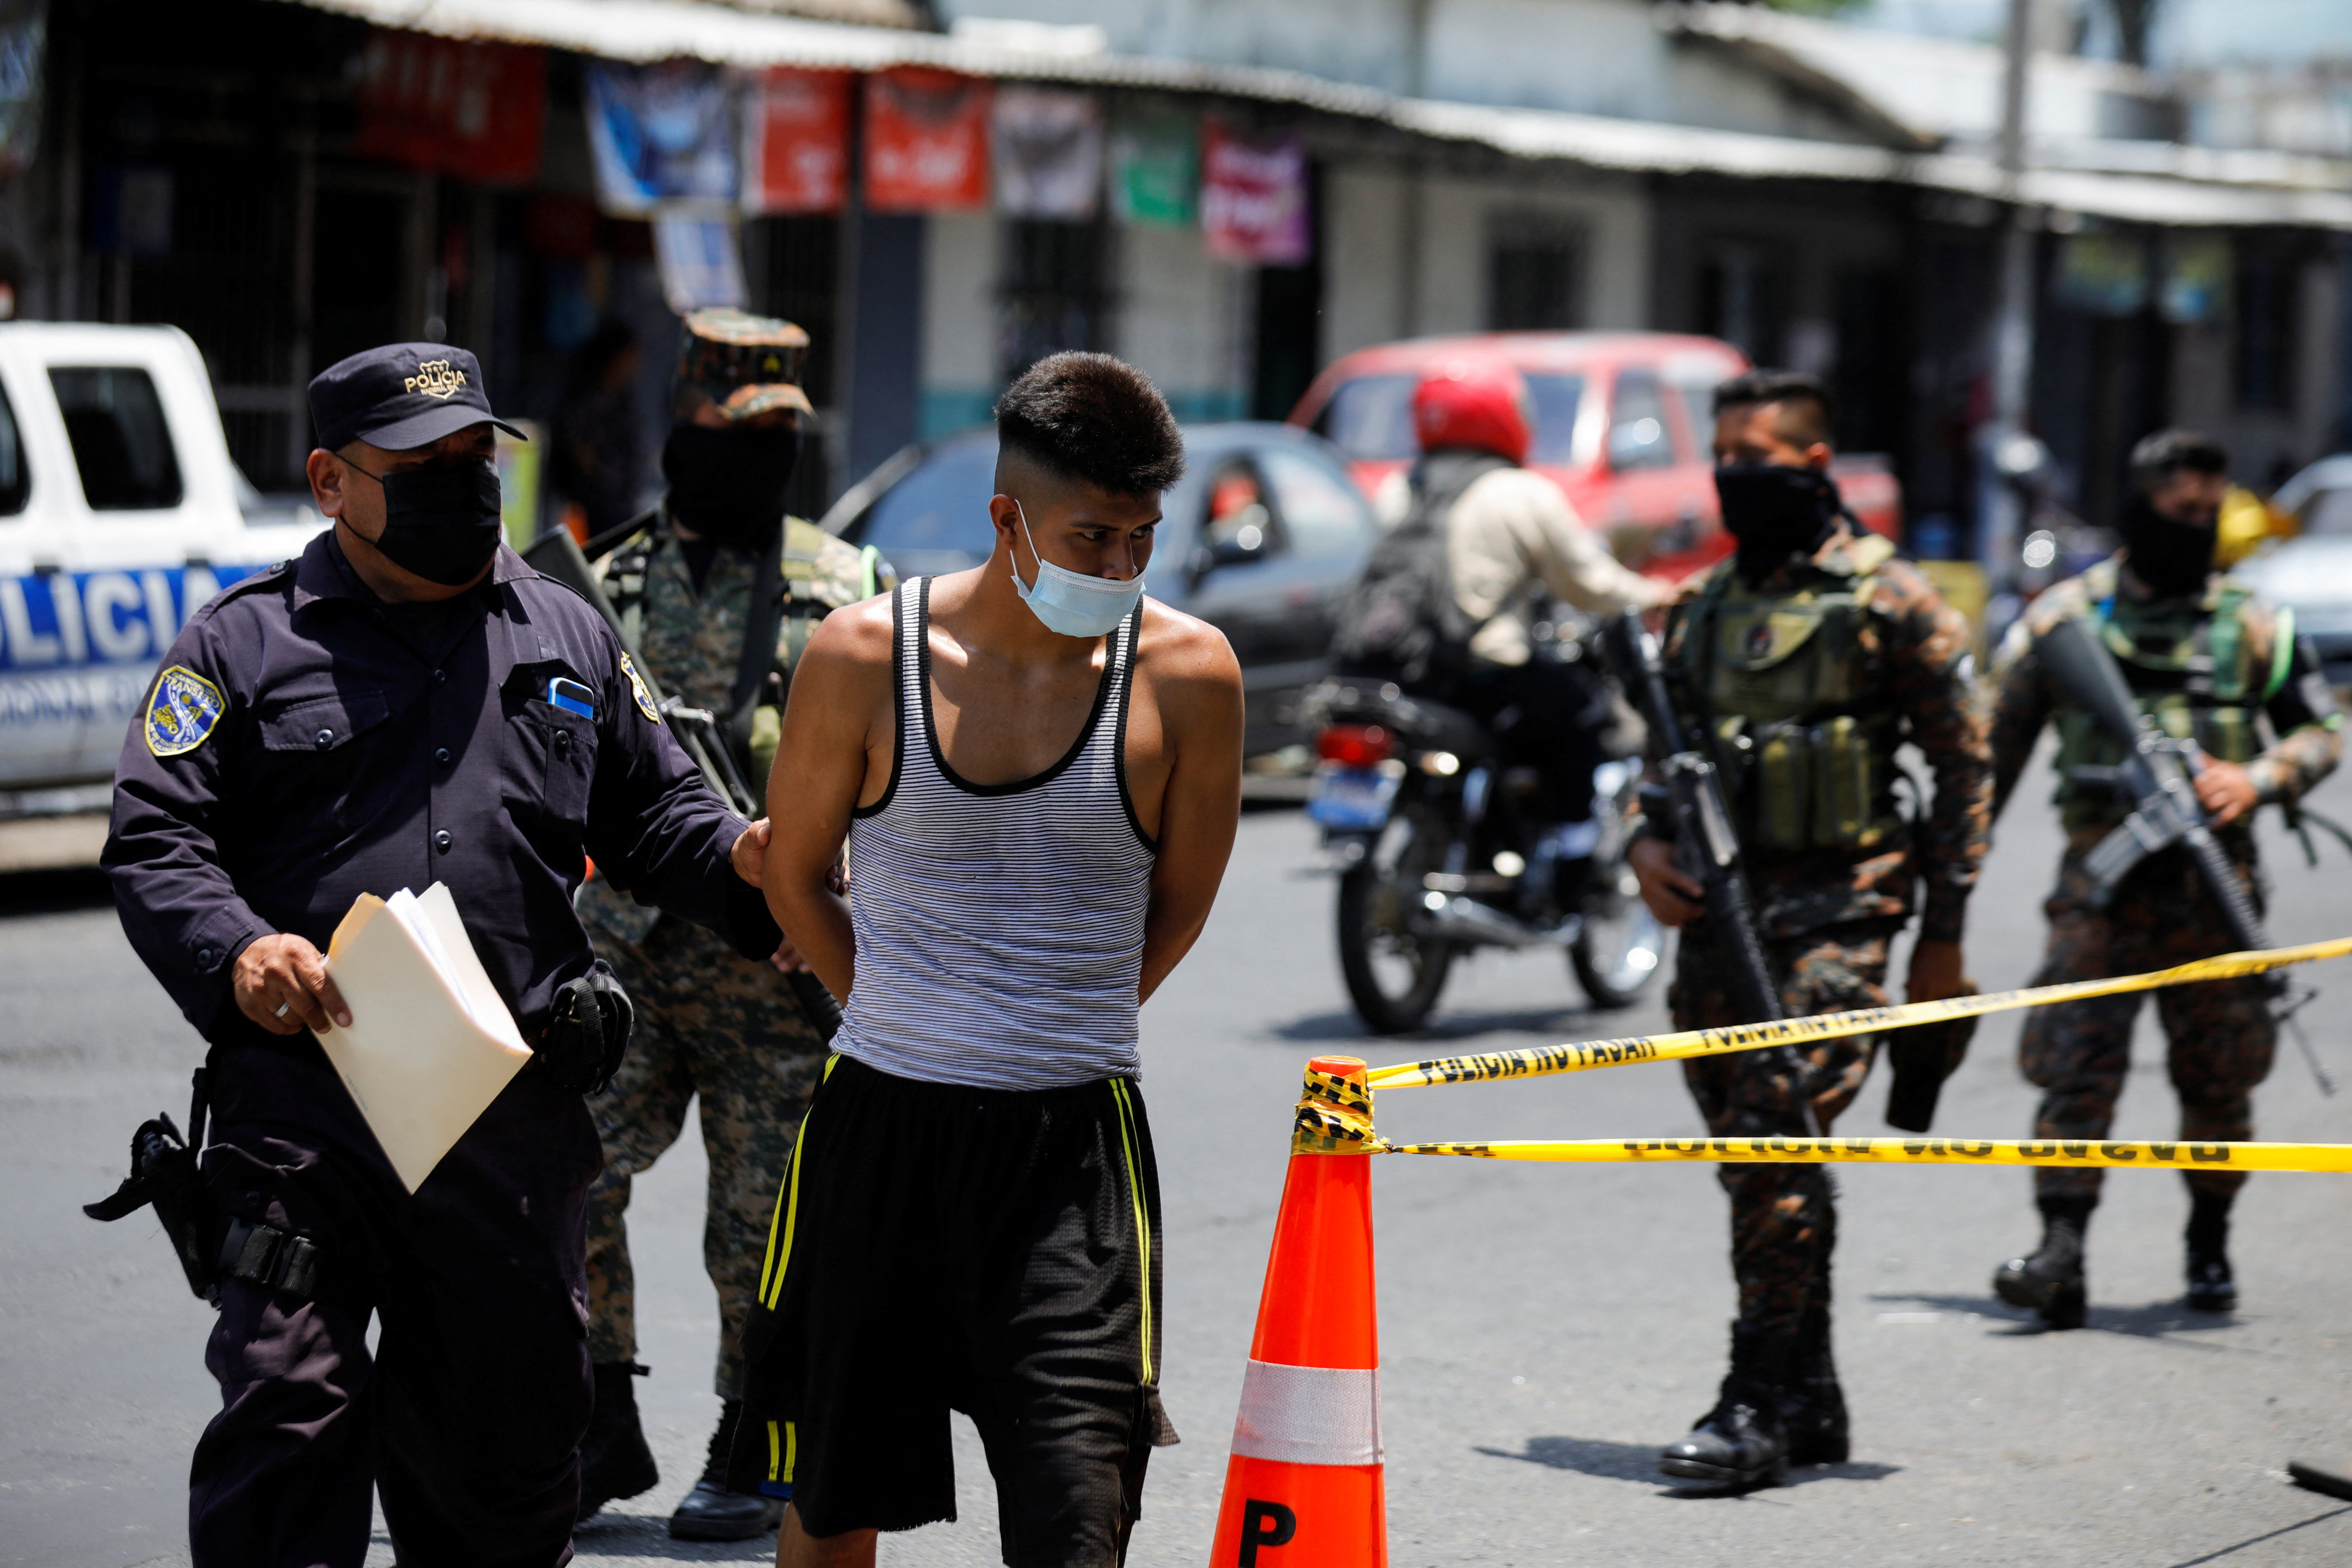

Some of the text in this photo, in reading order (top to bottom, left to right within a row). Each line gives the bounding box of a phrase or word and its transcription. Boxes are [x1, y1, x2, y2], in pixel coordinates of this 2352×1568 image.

[405, 370, 467, 393] POLICIA
[420, 385, 447, 396] NACIONAL
[0, 567, 222, 664] LICIA
[165, 674, 220, 708] TRANSITO
[1418, 1050, 1528, 1085] POLICIA
[1530, 1045, 1569, 1071] NO
[1238, 1498, 1296, 1568] P
